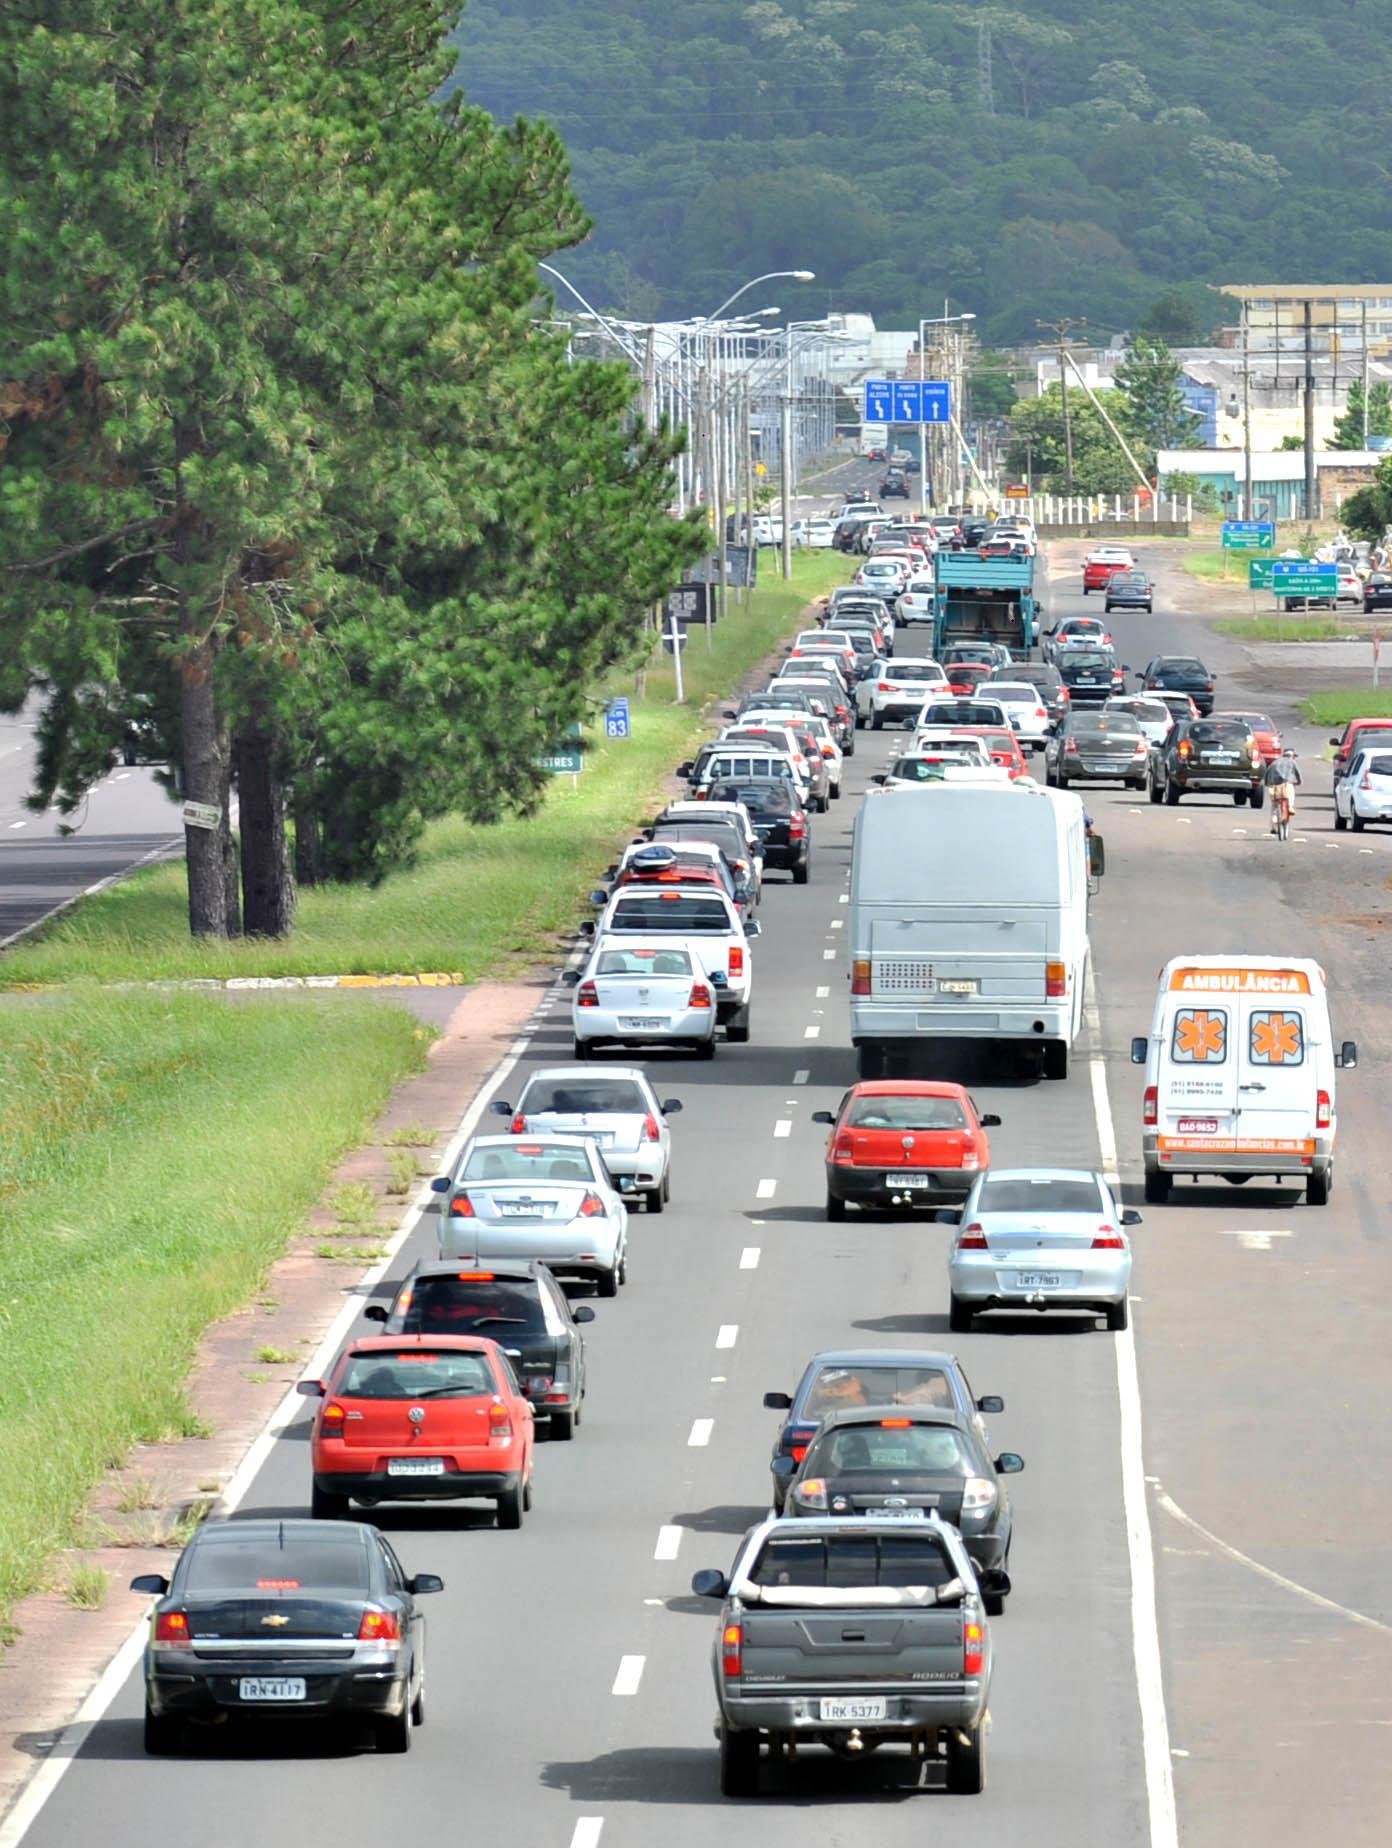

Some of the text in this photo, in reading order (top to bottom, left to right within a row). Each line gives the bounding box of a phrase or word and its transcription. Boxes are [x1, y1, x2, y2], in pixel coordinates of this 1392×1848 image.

[608, 720, 627, 738] 83
[1182, 972, 1300, 992] AMBULÂNCIA
[912, 1671, 960, 1681] RODEIO
